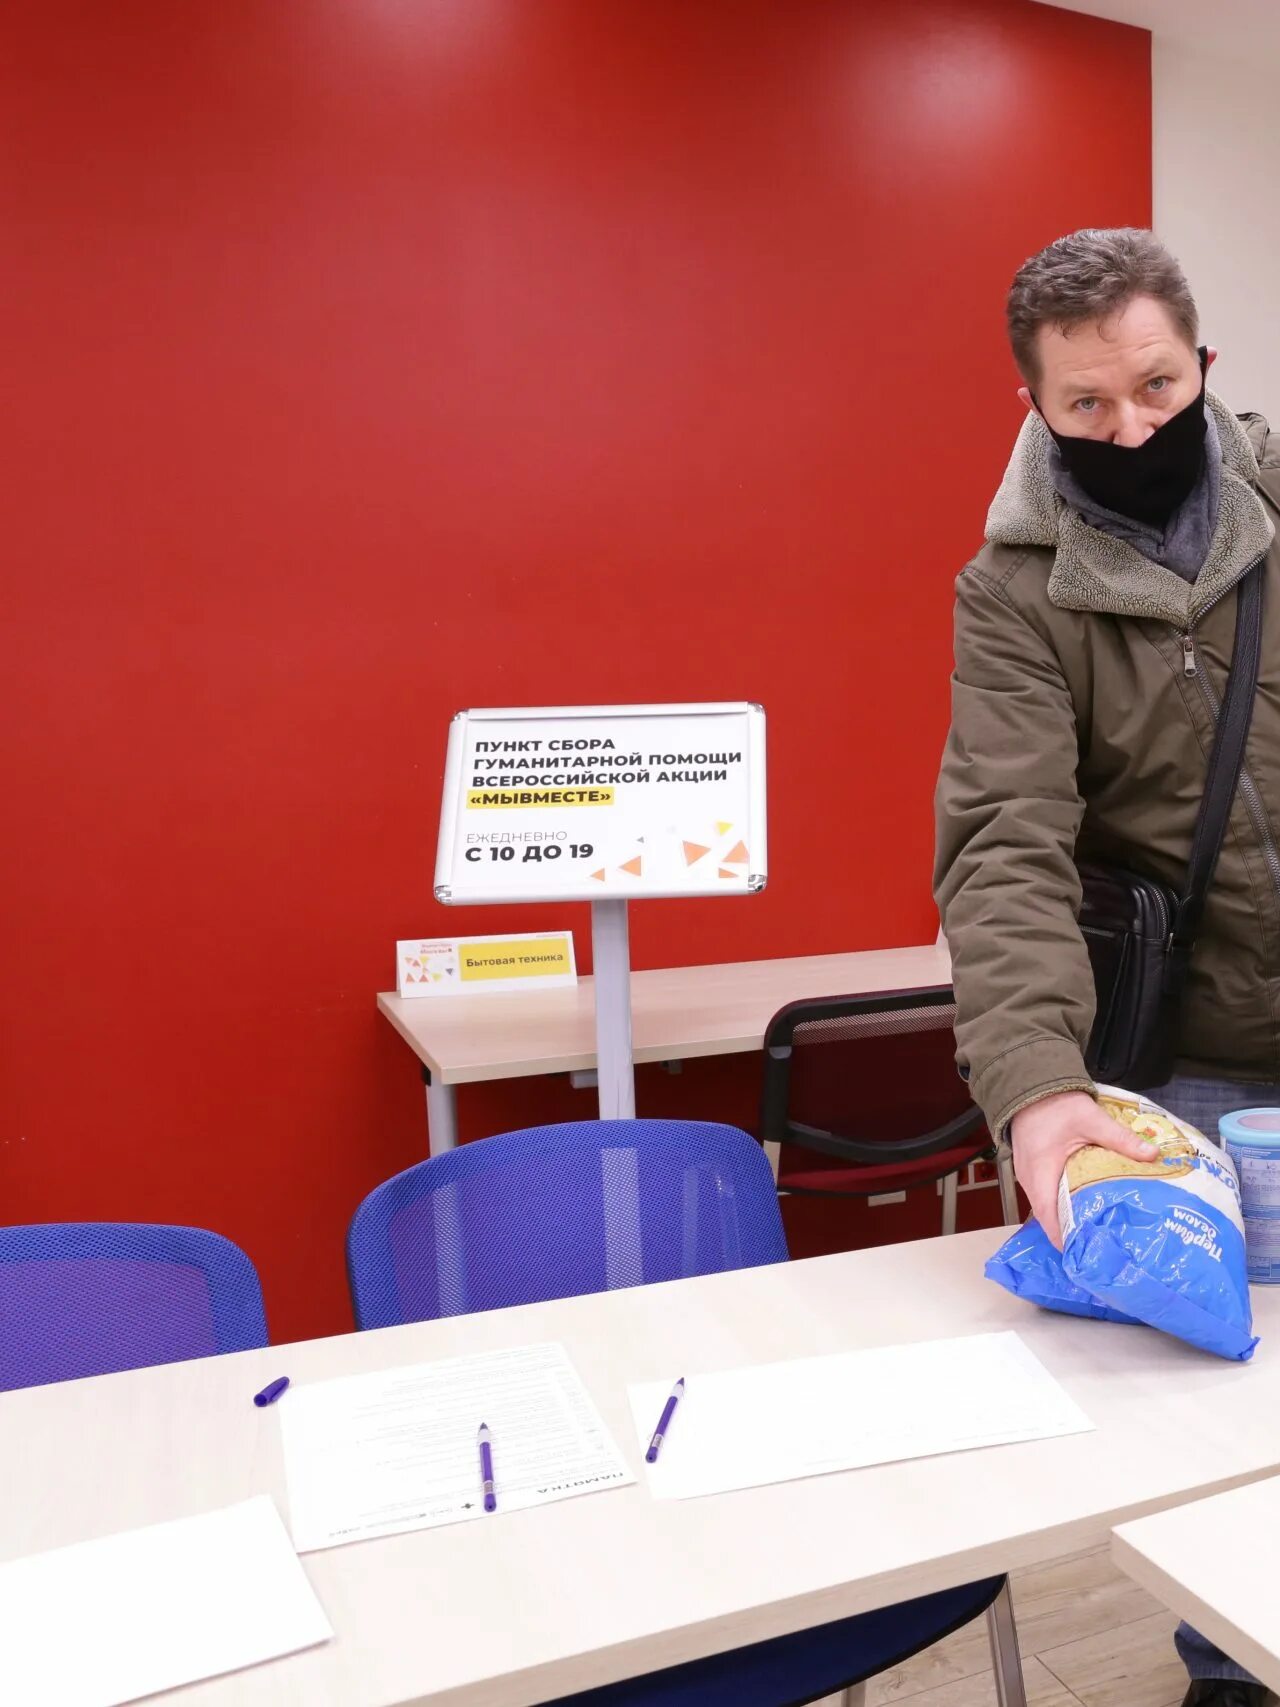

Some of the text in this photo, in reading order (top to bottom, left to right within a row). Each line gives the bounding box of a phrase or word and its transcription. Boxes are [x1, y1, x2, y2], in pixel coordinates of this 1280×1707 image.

[475, 738, 616, 753] ПУНКТ СБОРА
[473, 752, 742, 770] ГУМАНИТАРНОЙ ПОМОЩИ
[471, 769, 728, 788] ВСЕРОССИЙСКОЙ АКЦИИ
[470, 790, 611, 805] «МЫВМЕСТЕ»
[466, 830, 568, 845] ЕЖЕДНЕВНО
[464, 843, 594, 864] С 10 ДО 19
[466, 953, 564, 968] Бытовая техника
